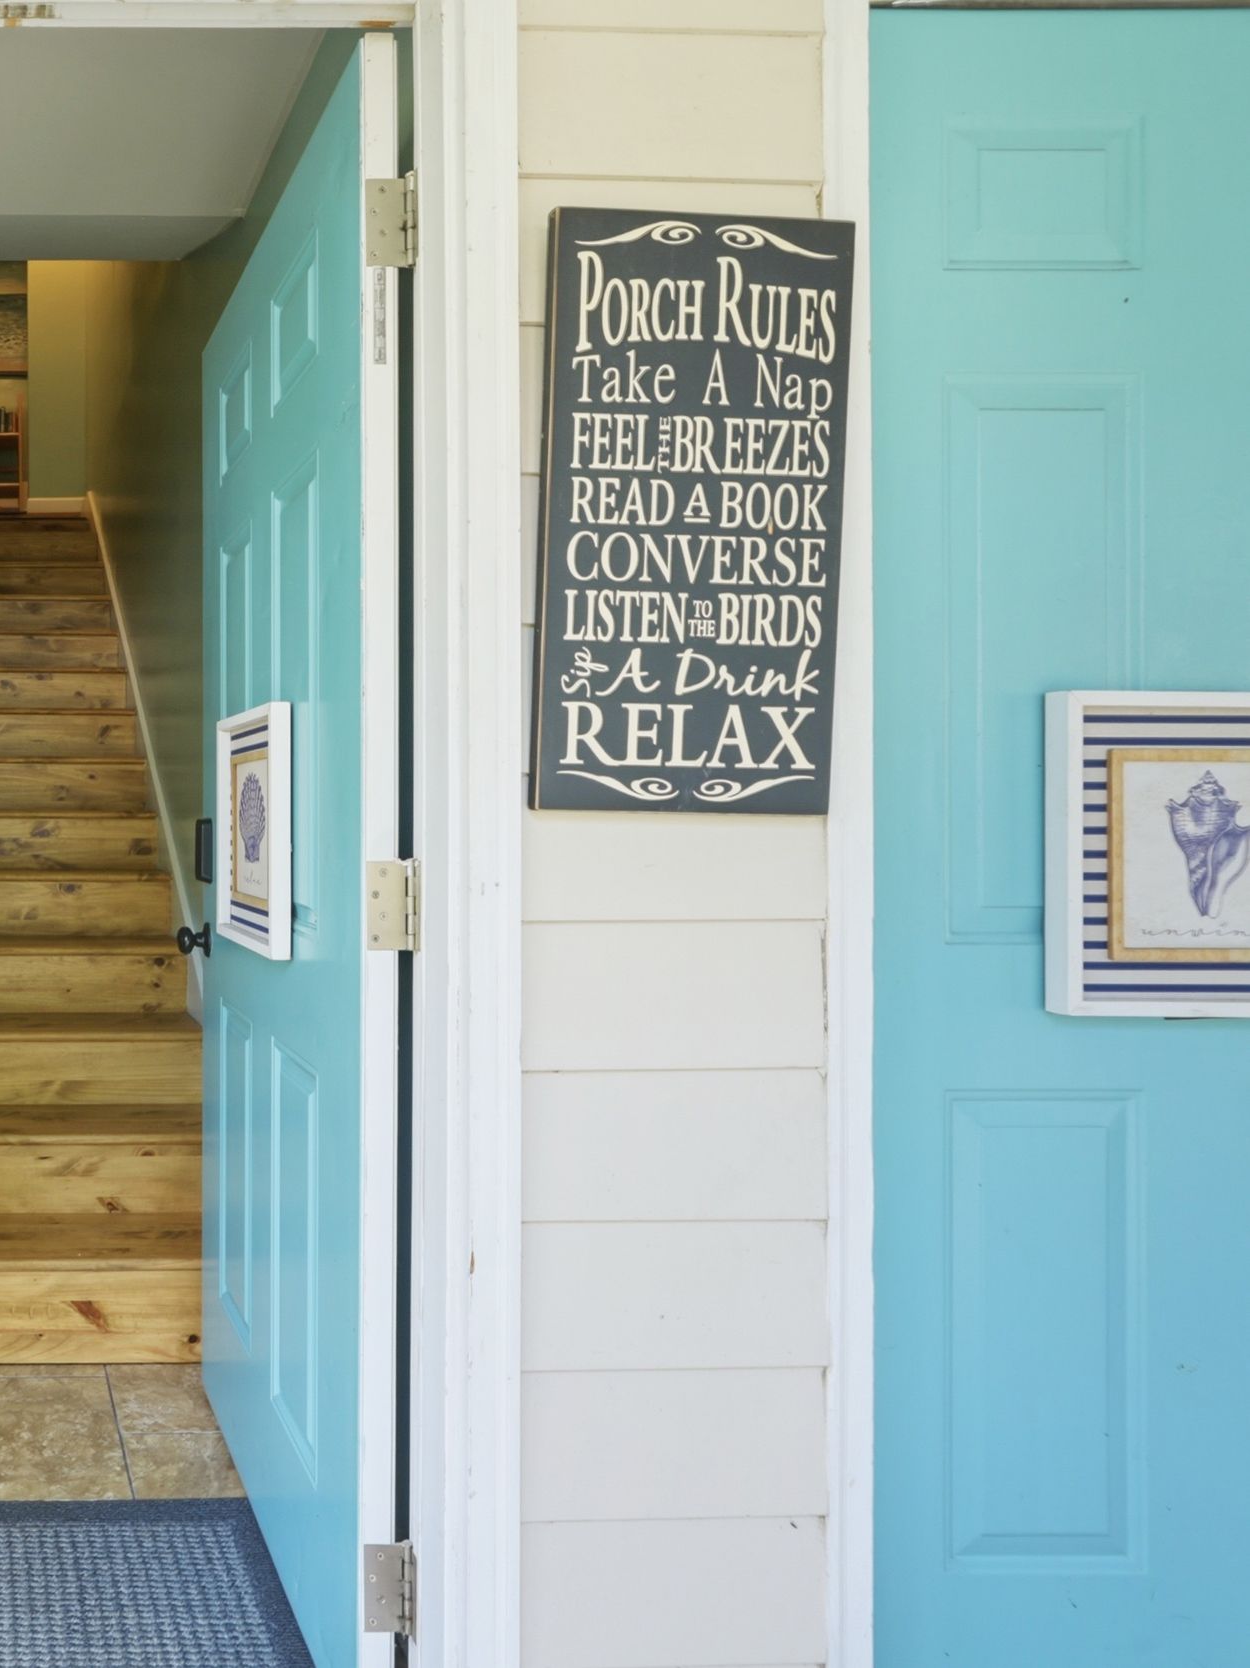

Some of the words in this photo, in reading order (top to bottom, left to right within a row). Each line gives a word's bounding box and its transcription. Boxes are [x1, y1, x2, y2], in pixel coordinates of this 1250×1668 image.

[575, 250, 706, 353] PORCH
[713, 256, 837, 365] RULES
[571, 349, 676, 404] Take
[701, 348, 730, 406] A
[753, 353, 833, 420] Nap
[569, 411, 656, 472] FEEL
[657, 415, 672, 474] THE
[669, 415, 831, 479] BREEZES
[569, 476, 675, 526] READ
[682, 482, 711, 523] A
[719, 481, 828, 531] BOOK
[566, 530, 827, 588] CONVERSE
[562, 588, 690, 645] LISTEN
[687, 618, 716, 638] THE
[692, 599, 713, 619] TO
[715, 592, 823, 648] BIRDS
[560, 646, 610, 699] Sip
[594, 647, 661, 697] A
[674, 647, 820, 702] Drink
[558, 700, 816, 770] RELAX
